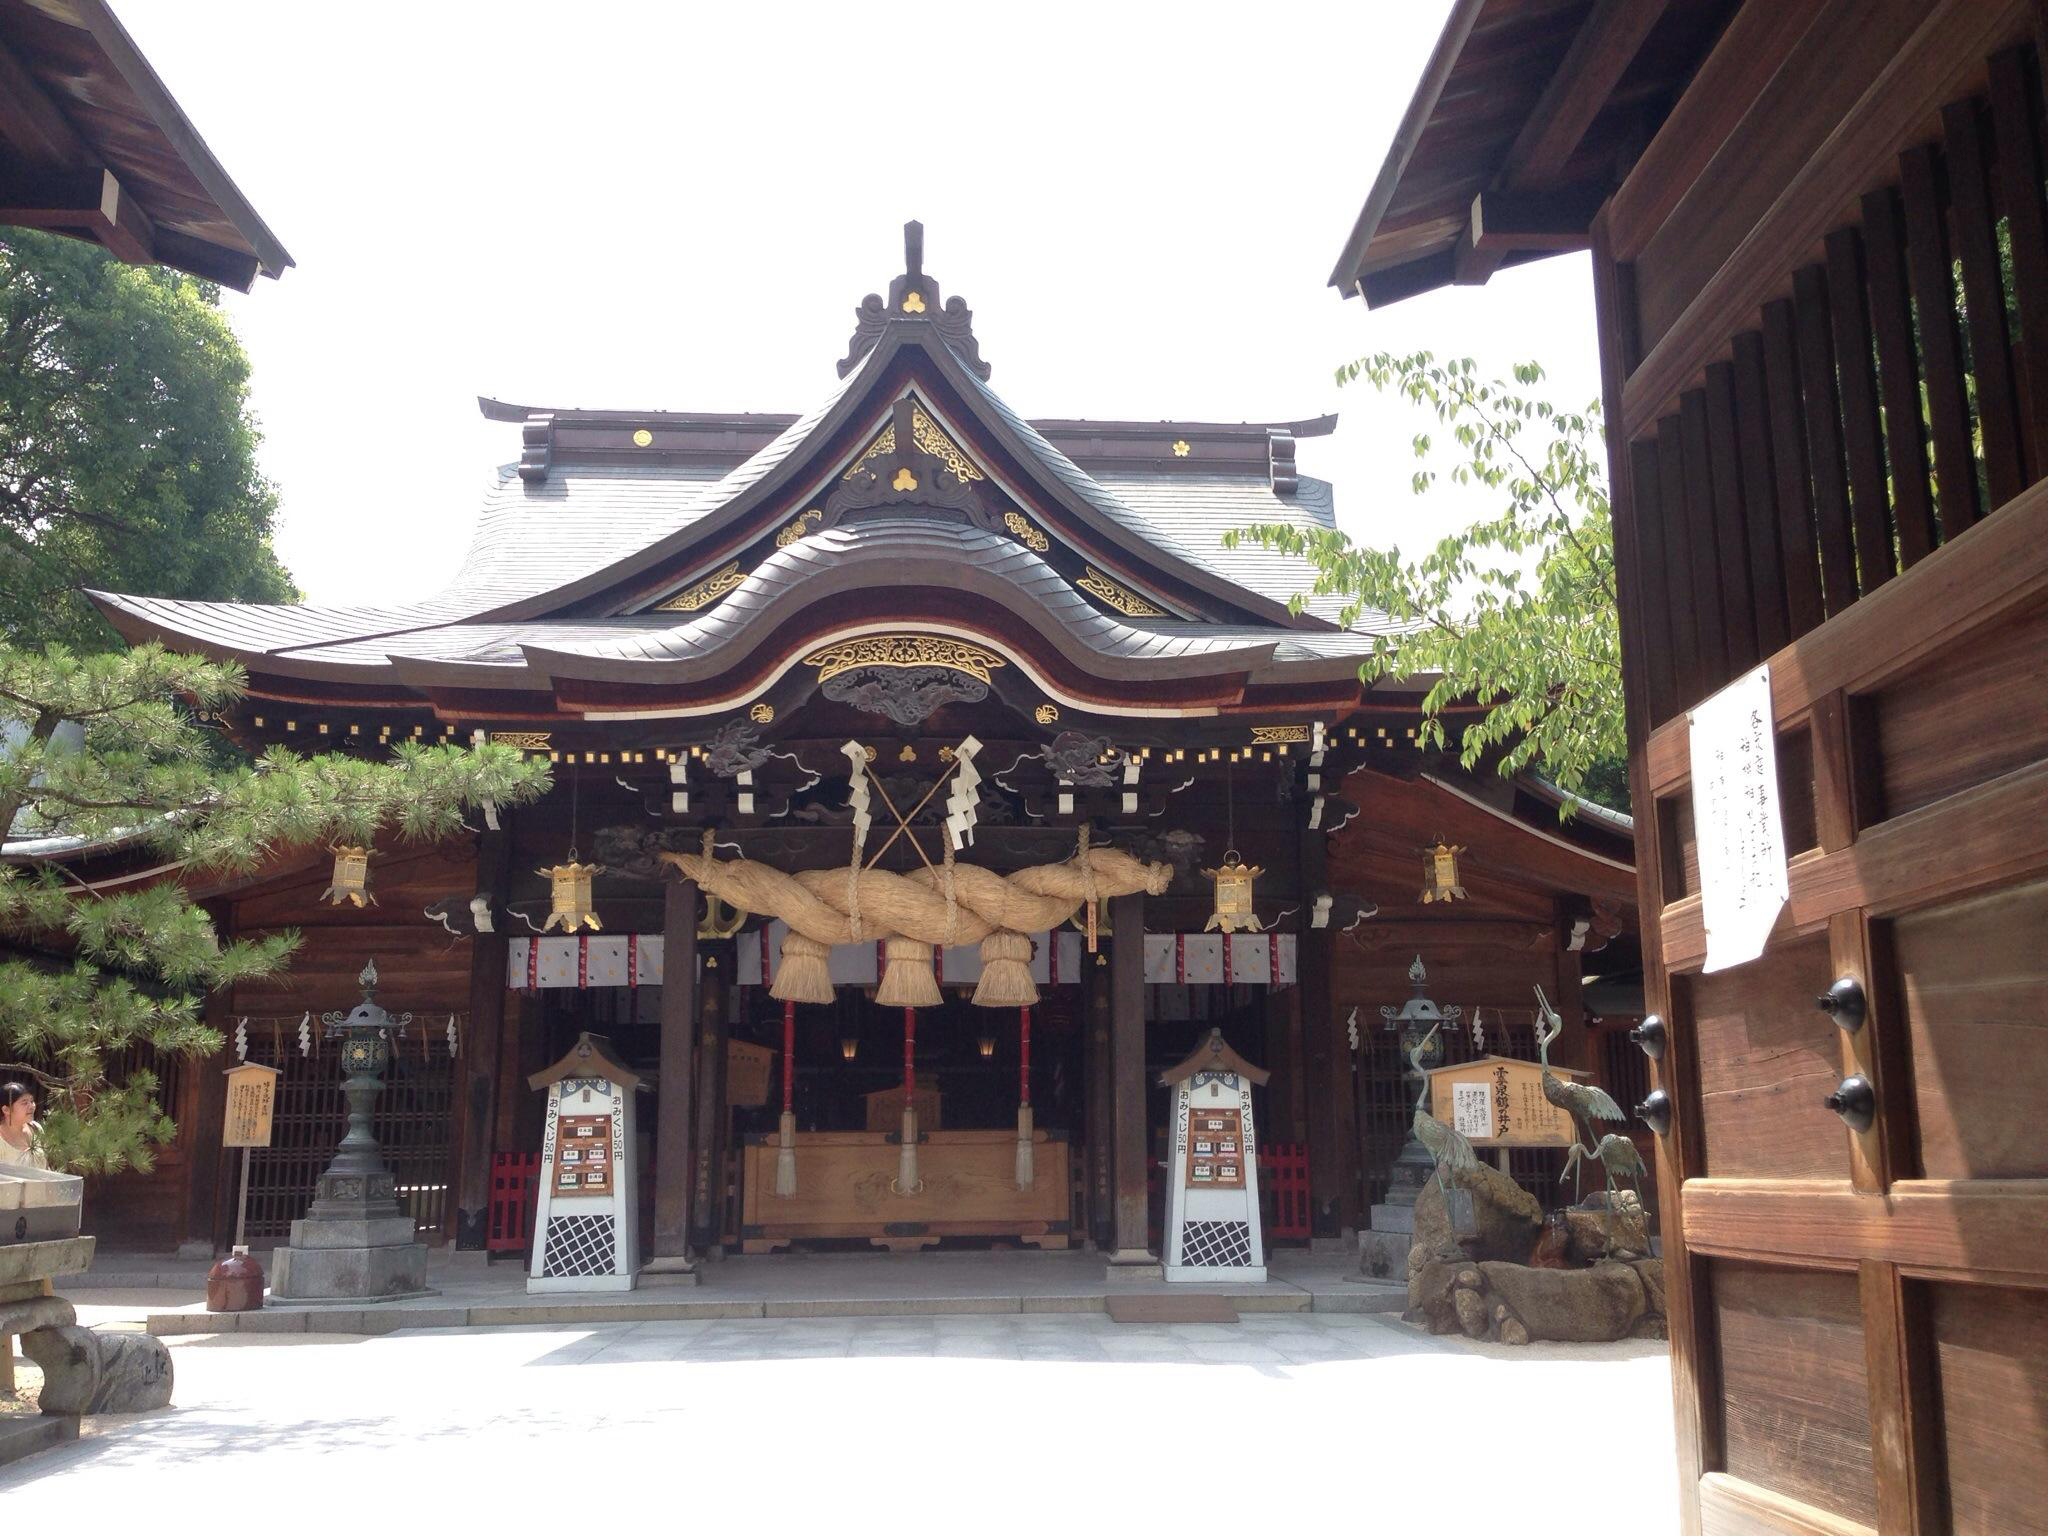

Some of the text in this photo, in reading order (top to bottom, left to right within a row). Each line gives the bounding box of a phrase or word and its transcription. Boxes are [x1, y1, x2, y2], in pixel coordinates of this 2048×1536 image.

[543, 1098, 559, 1164] おみくじ50円
[611, 1095, 624, 1161] おみくじ50円
[1177, 1090, 1189, 1155] おみくじ50円
[1240, 1090, 1254, 1155] おみくじ50円
